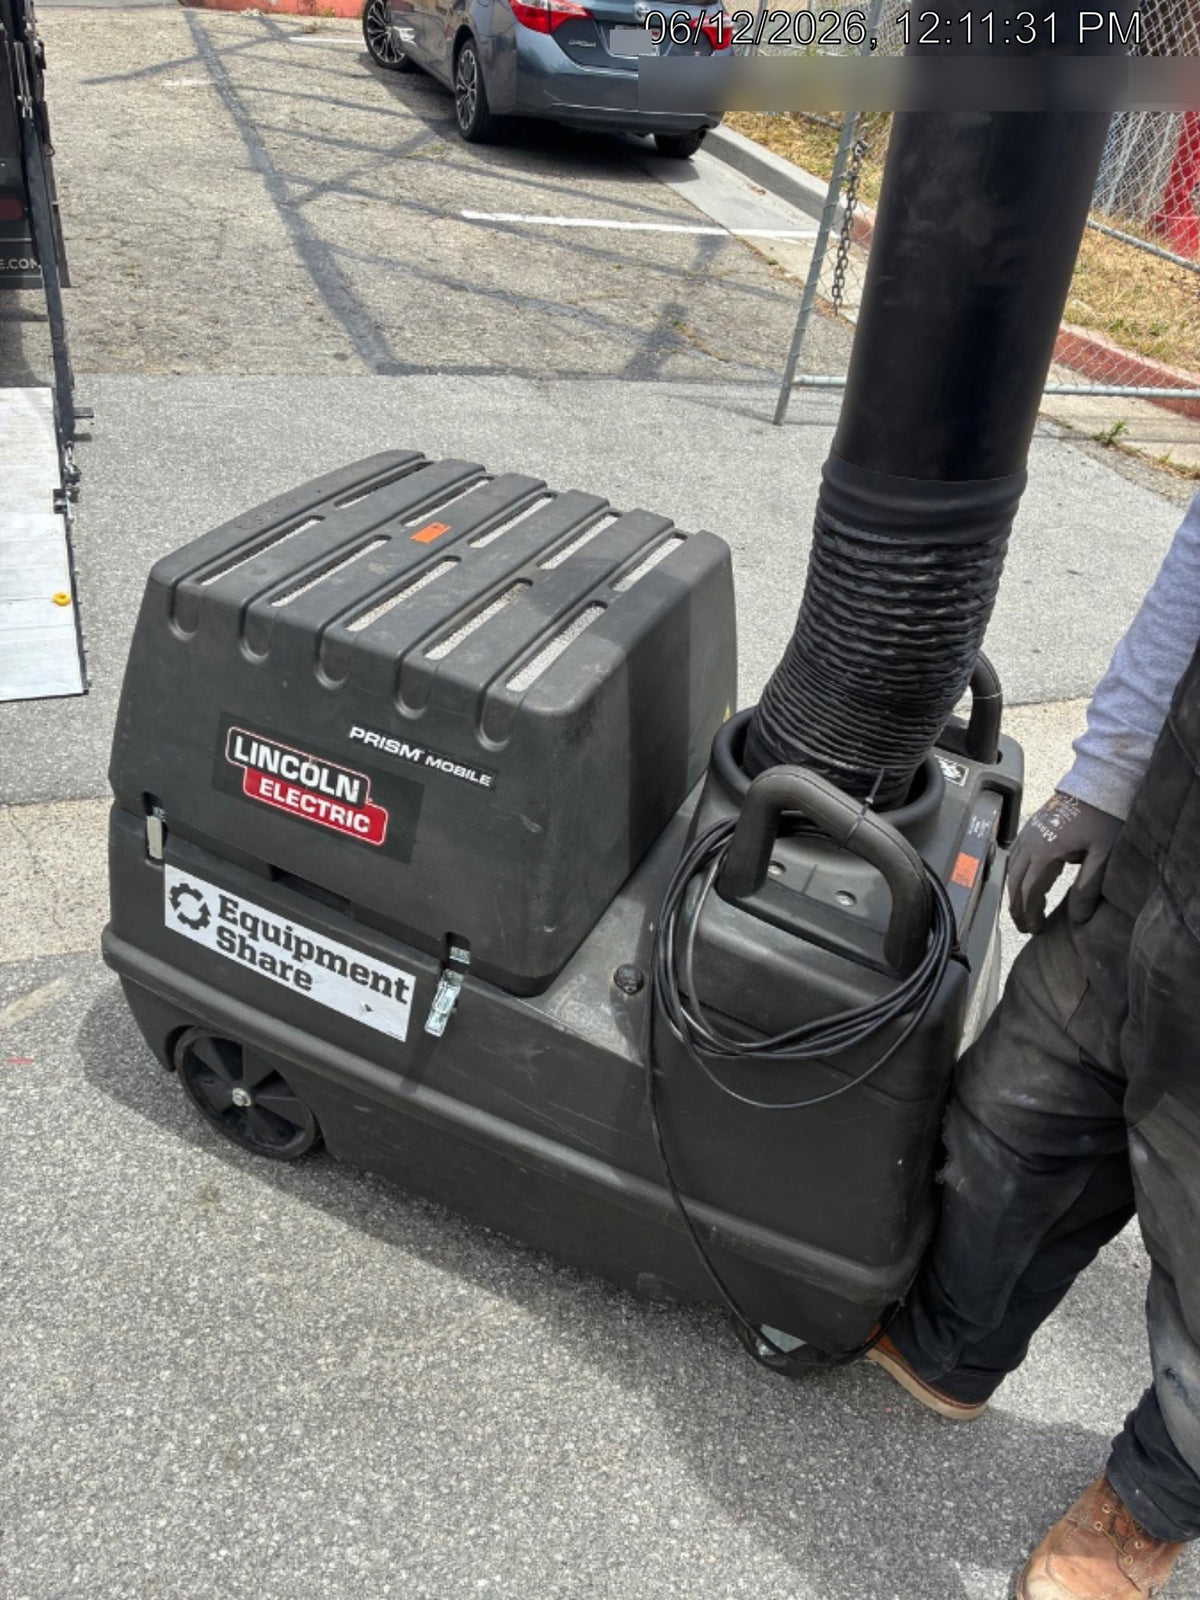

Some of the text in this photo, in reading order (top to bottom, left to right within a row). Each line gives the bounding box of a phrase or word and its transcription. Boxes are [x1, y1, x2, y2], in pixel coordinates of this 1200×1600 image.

[234, 735, 359, 803] LINCOLN
[425, 755, 492, 787] MOBILE
[259, 777, 370, 833] ELECTRIC
[216, 925, 313, 992] Share
[218, 893, 410, 1004] Equipment
